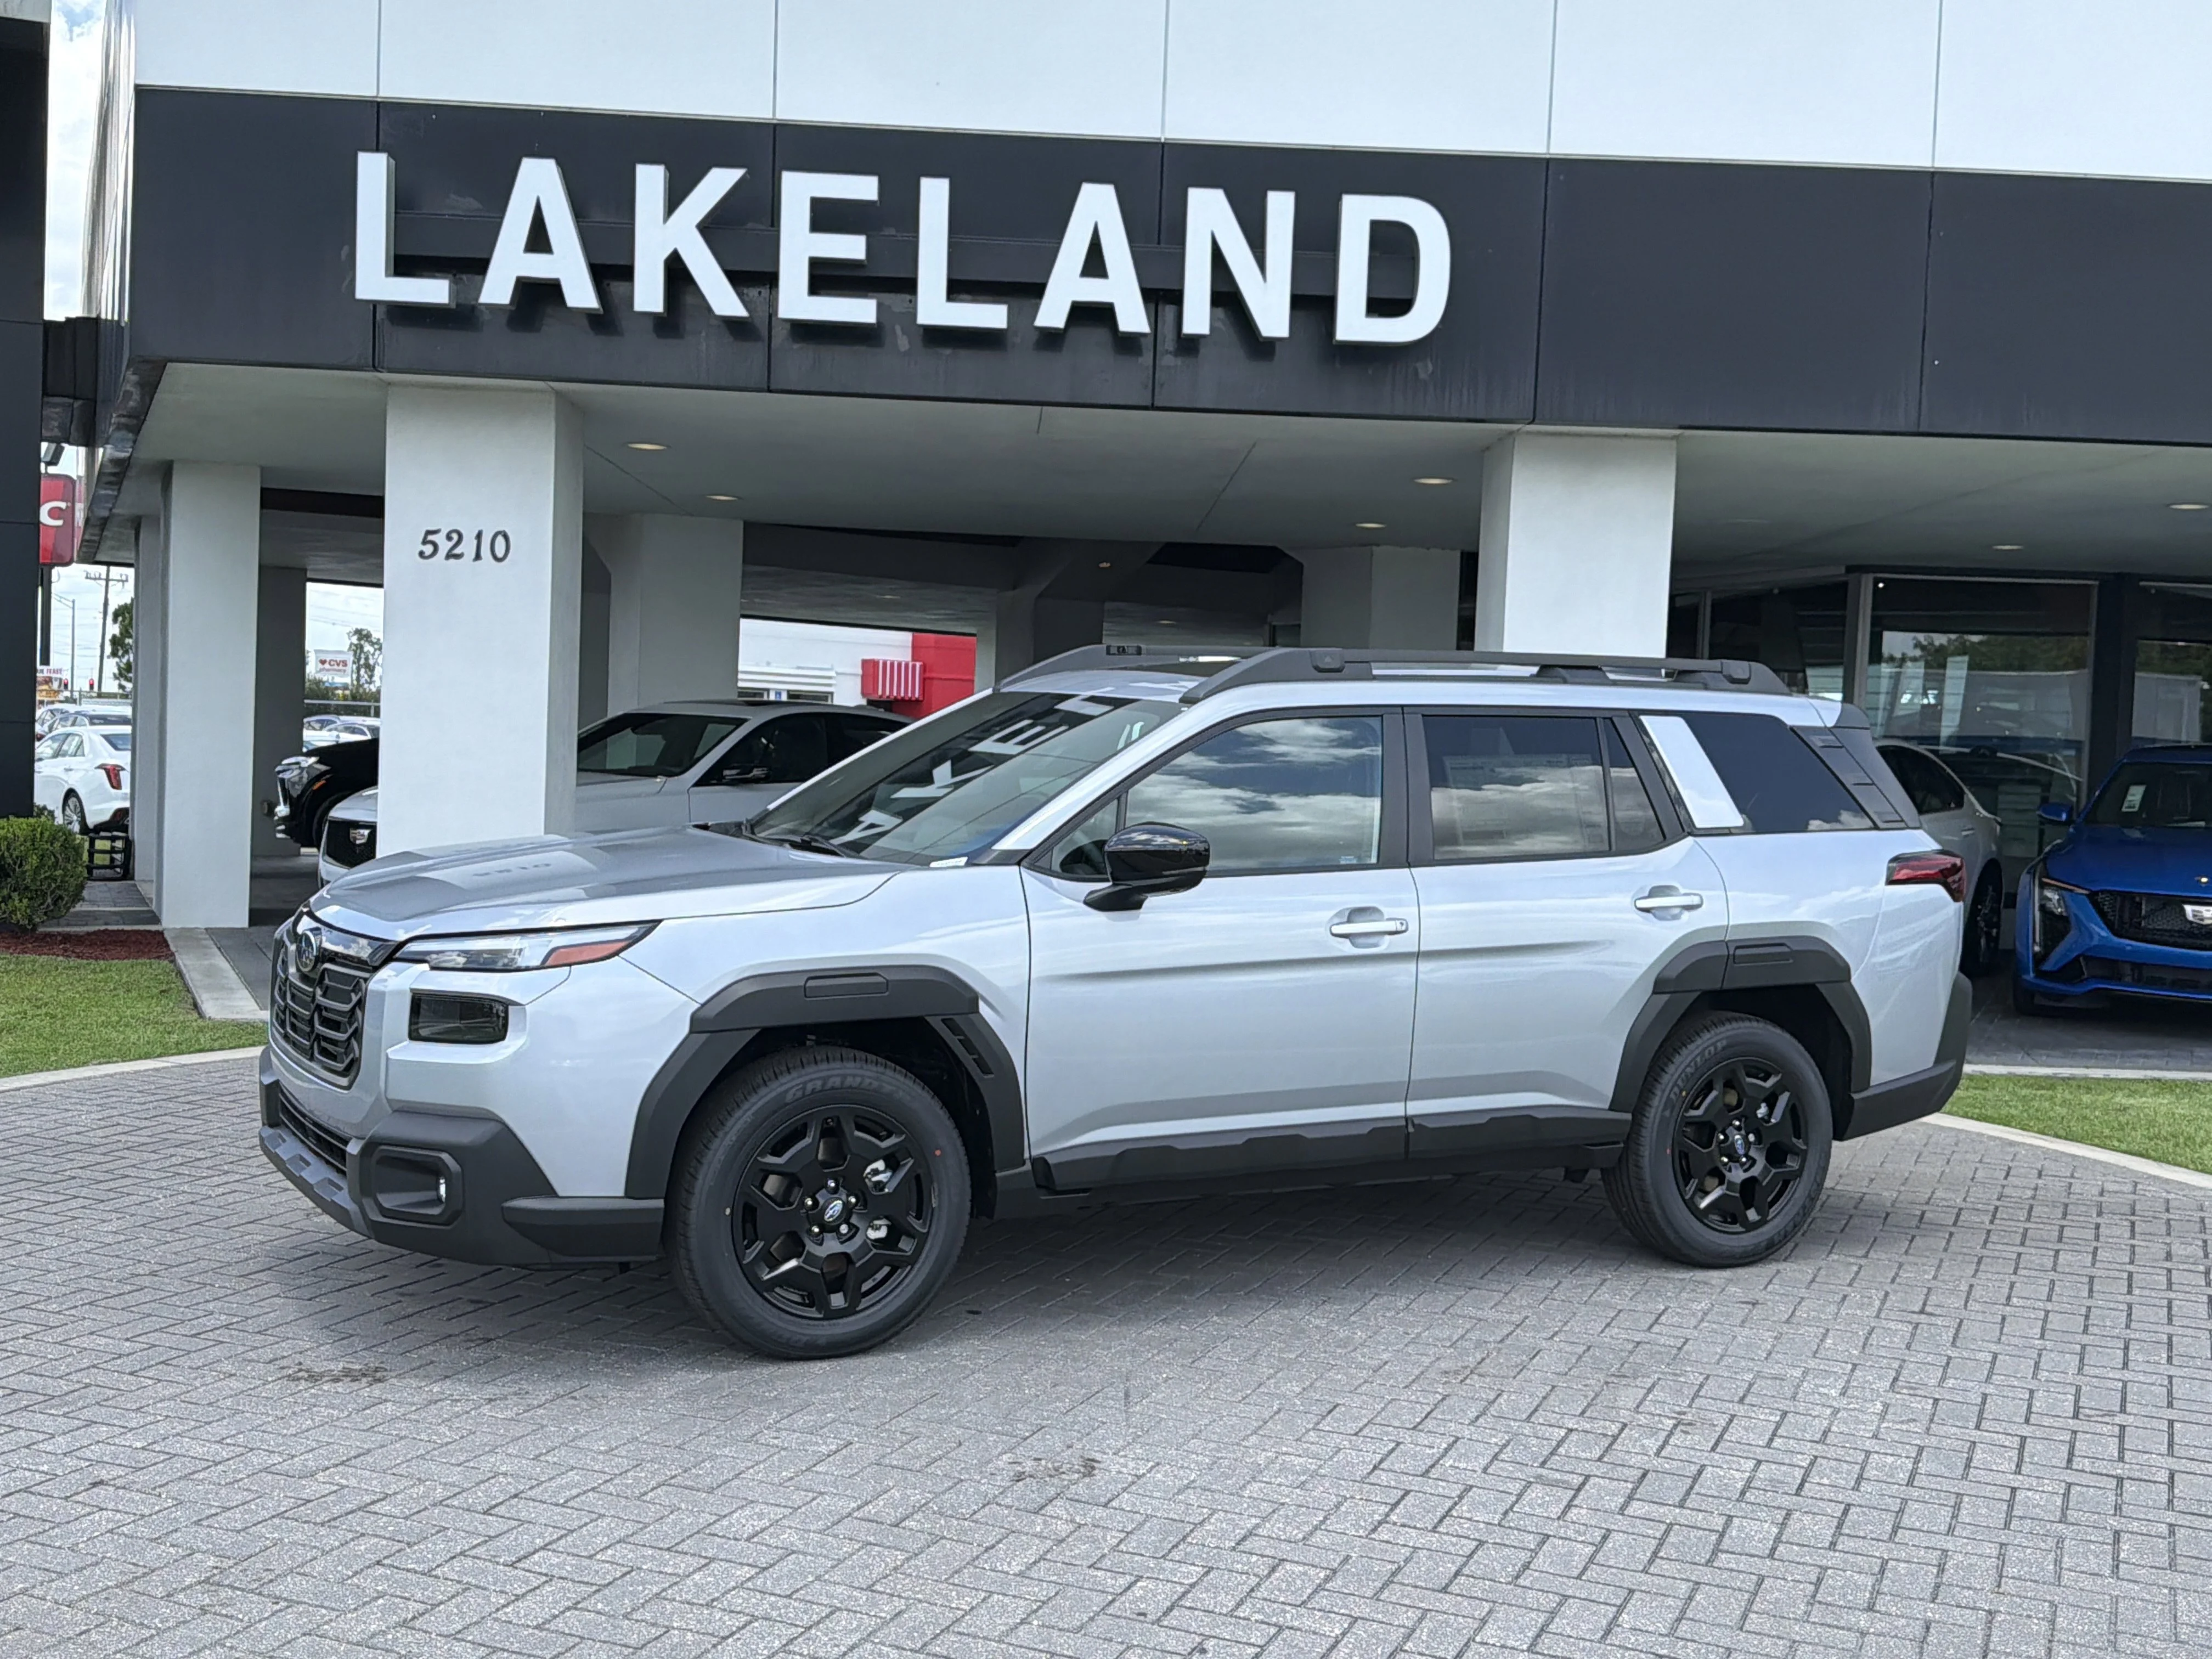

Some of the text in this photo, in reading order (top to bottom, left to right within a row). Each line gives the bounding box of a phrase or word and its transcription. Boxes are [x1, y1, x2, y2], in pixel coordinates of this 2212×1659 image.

[355, 151, 1451, 345] LAKELAND
[418, 528, 511, 562] 5210
[329, 659, 348, 667] CVS
[1669, 1040, 1727, 1104] DUNLOP
